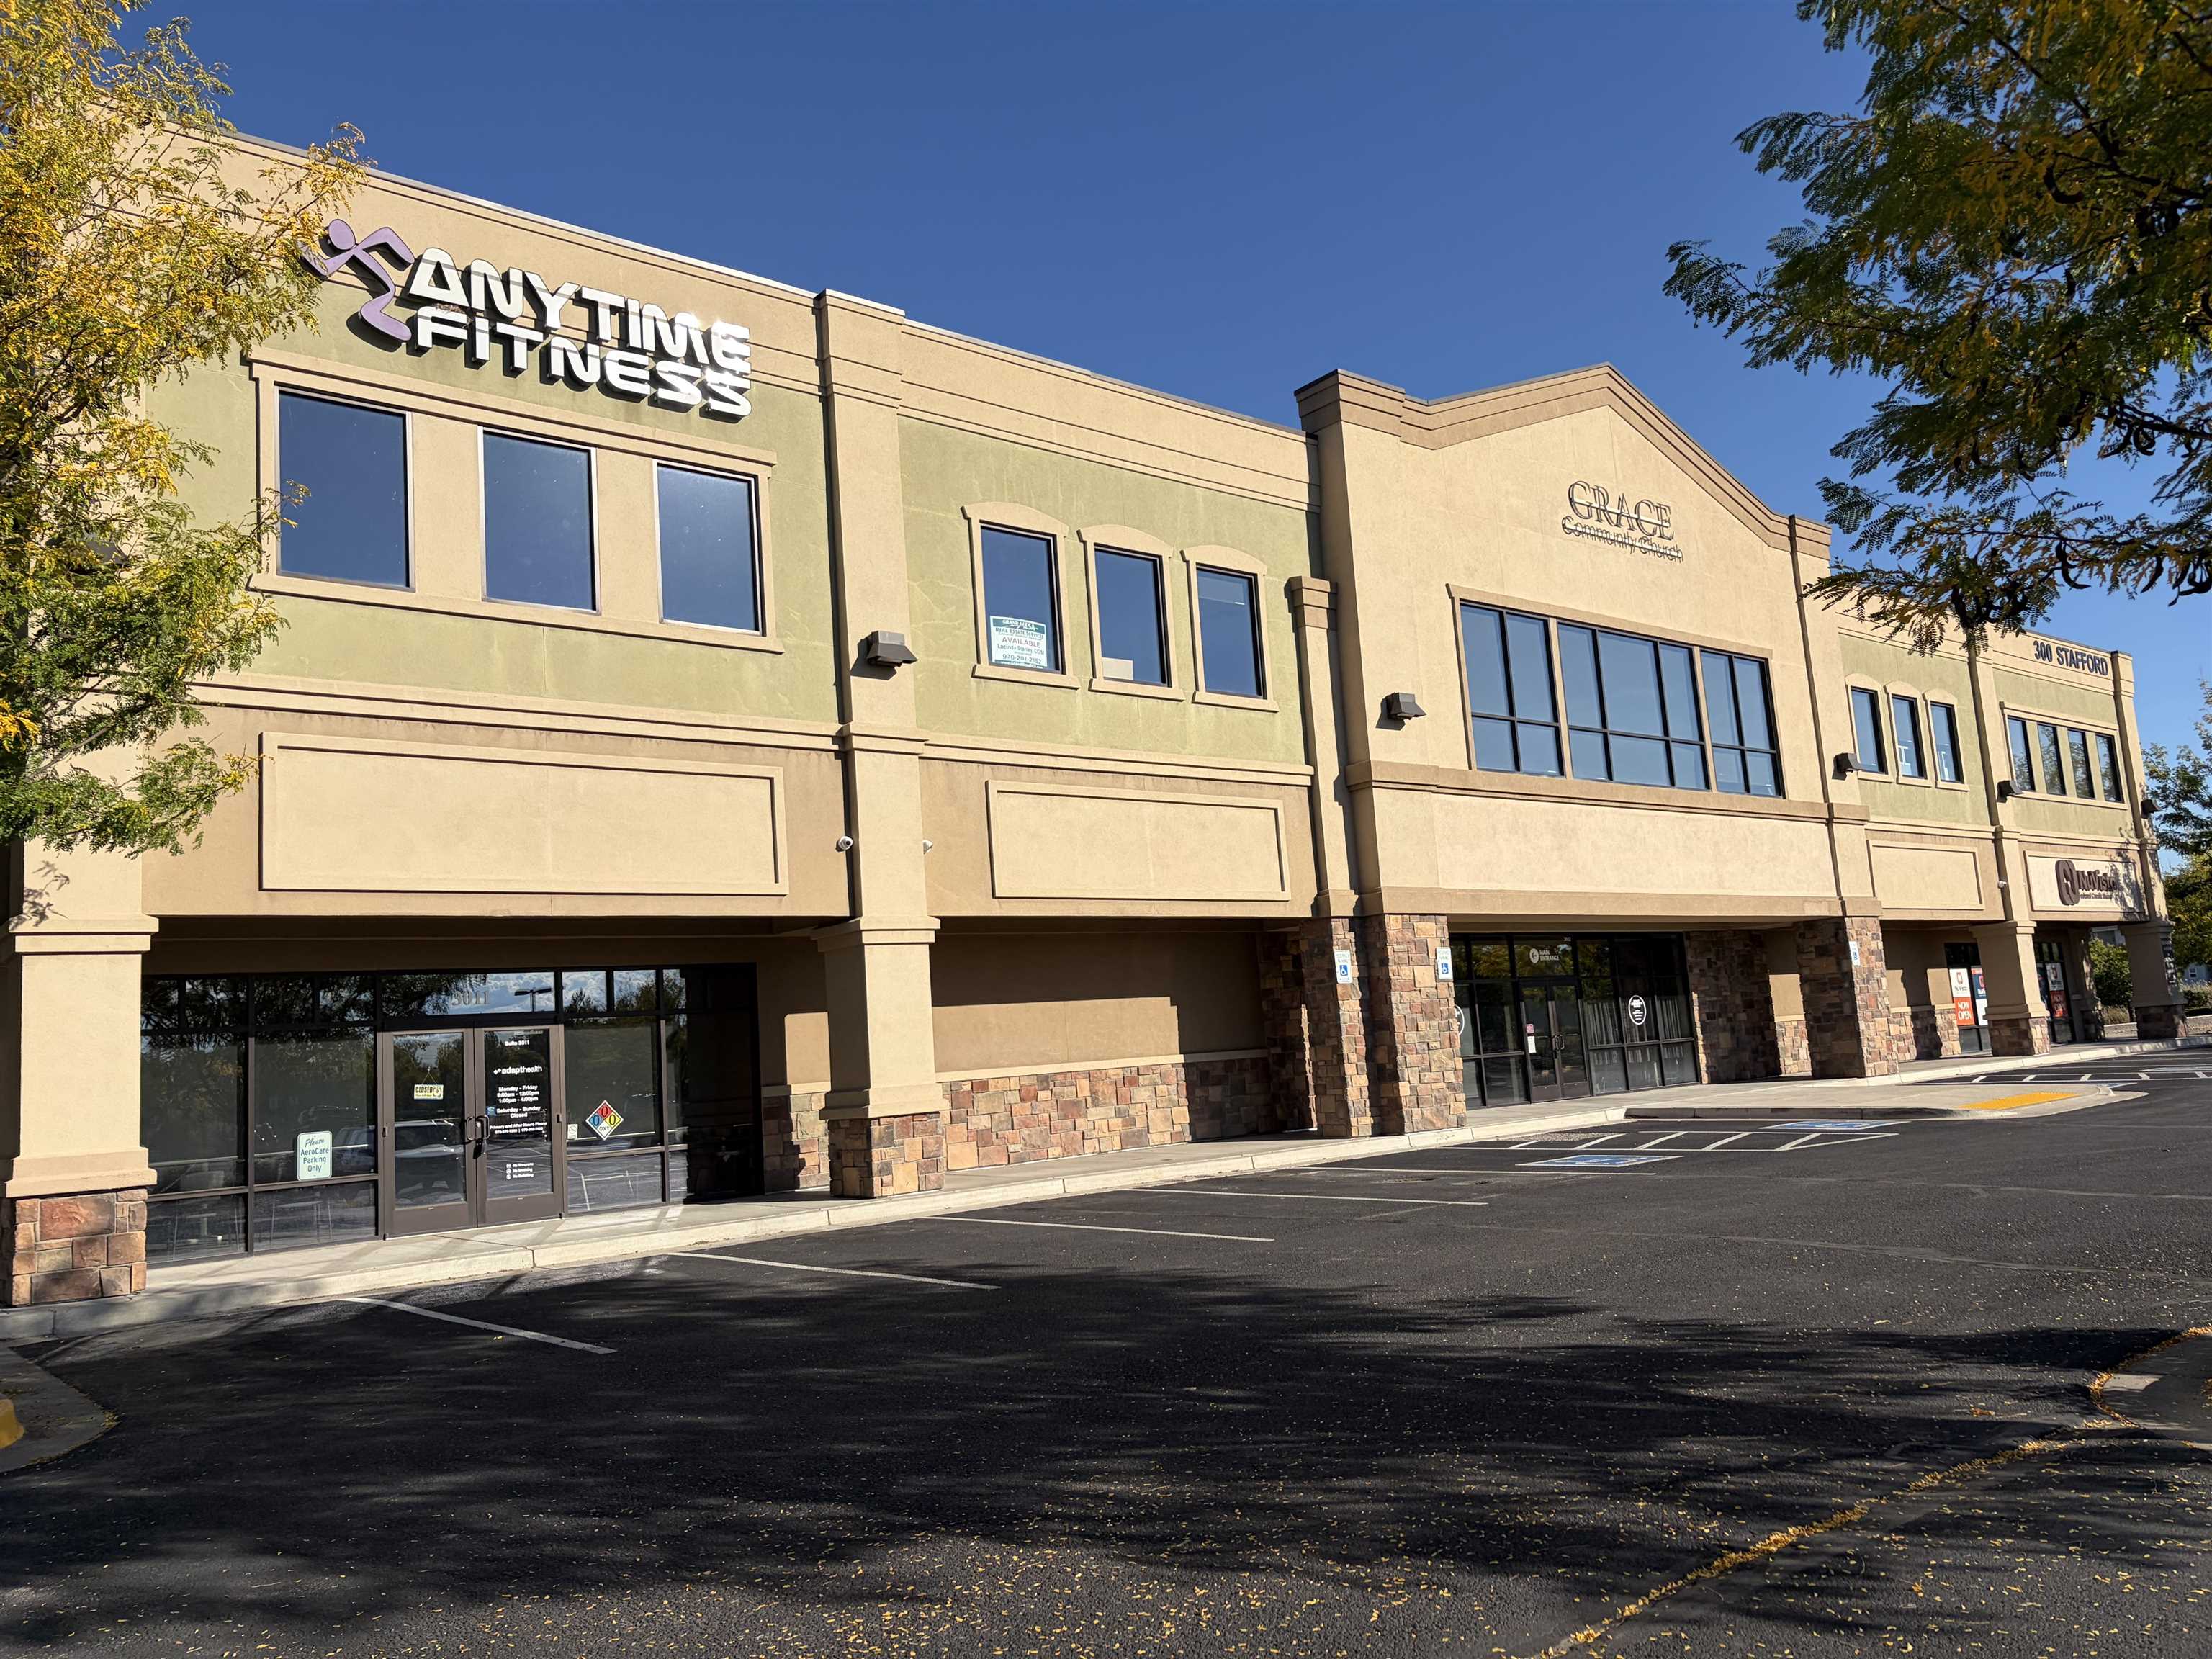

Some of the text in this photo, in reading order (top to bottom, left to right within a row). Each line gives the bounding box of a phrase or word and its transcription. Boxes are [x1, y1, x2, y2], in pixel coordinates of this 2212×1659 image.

[409, 248, 750, 374] ANYTIME
[416, 306, 752, 416] FITNESS
[1568, 481, 1674, 540] GRACE
[1562, 516, 1683, 563] Community Church
[1002, 637, 1040, 649] AVAILABLE
[2033, 640, 2108, 676] 300 STAFFORD
[451, 990, 490, 1005] 3011
[1958, 1011, 1972, 1020] OPEN
[501, 1065, 543, 1075] adapthealth
[601, 1106, 608, 1118] 0
[593, 1115, 599, 1125] 0
[609, 1114, 616, 1125] 0
[305, 1138, 325, 1148] Please
[300, 1148, 329, 1156] AeroCare
